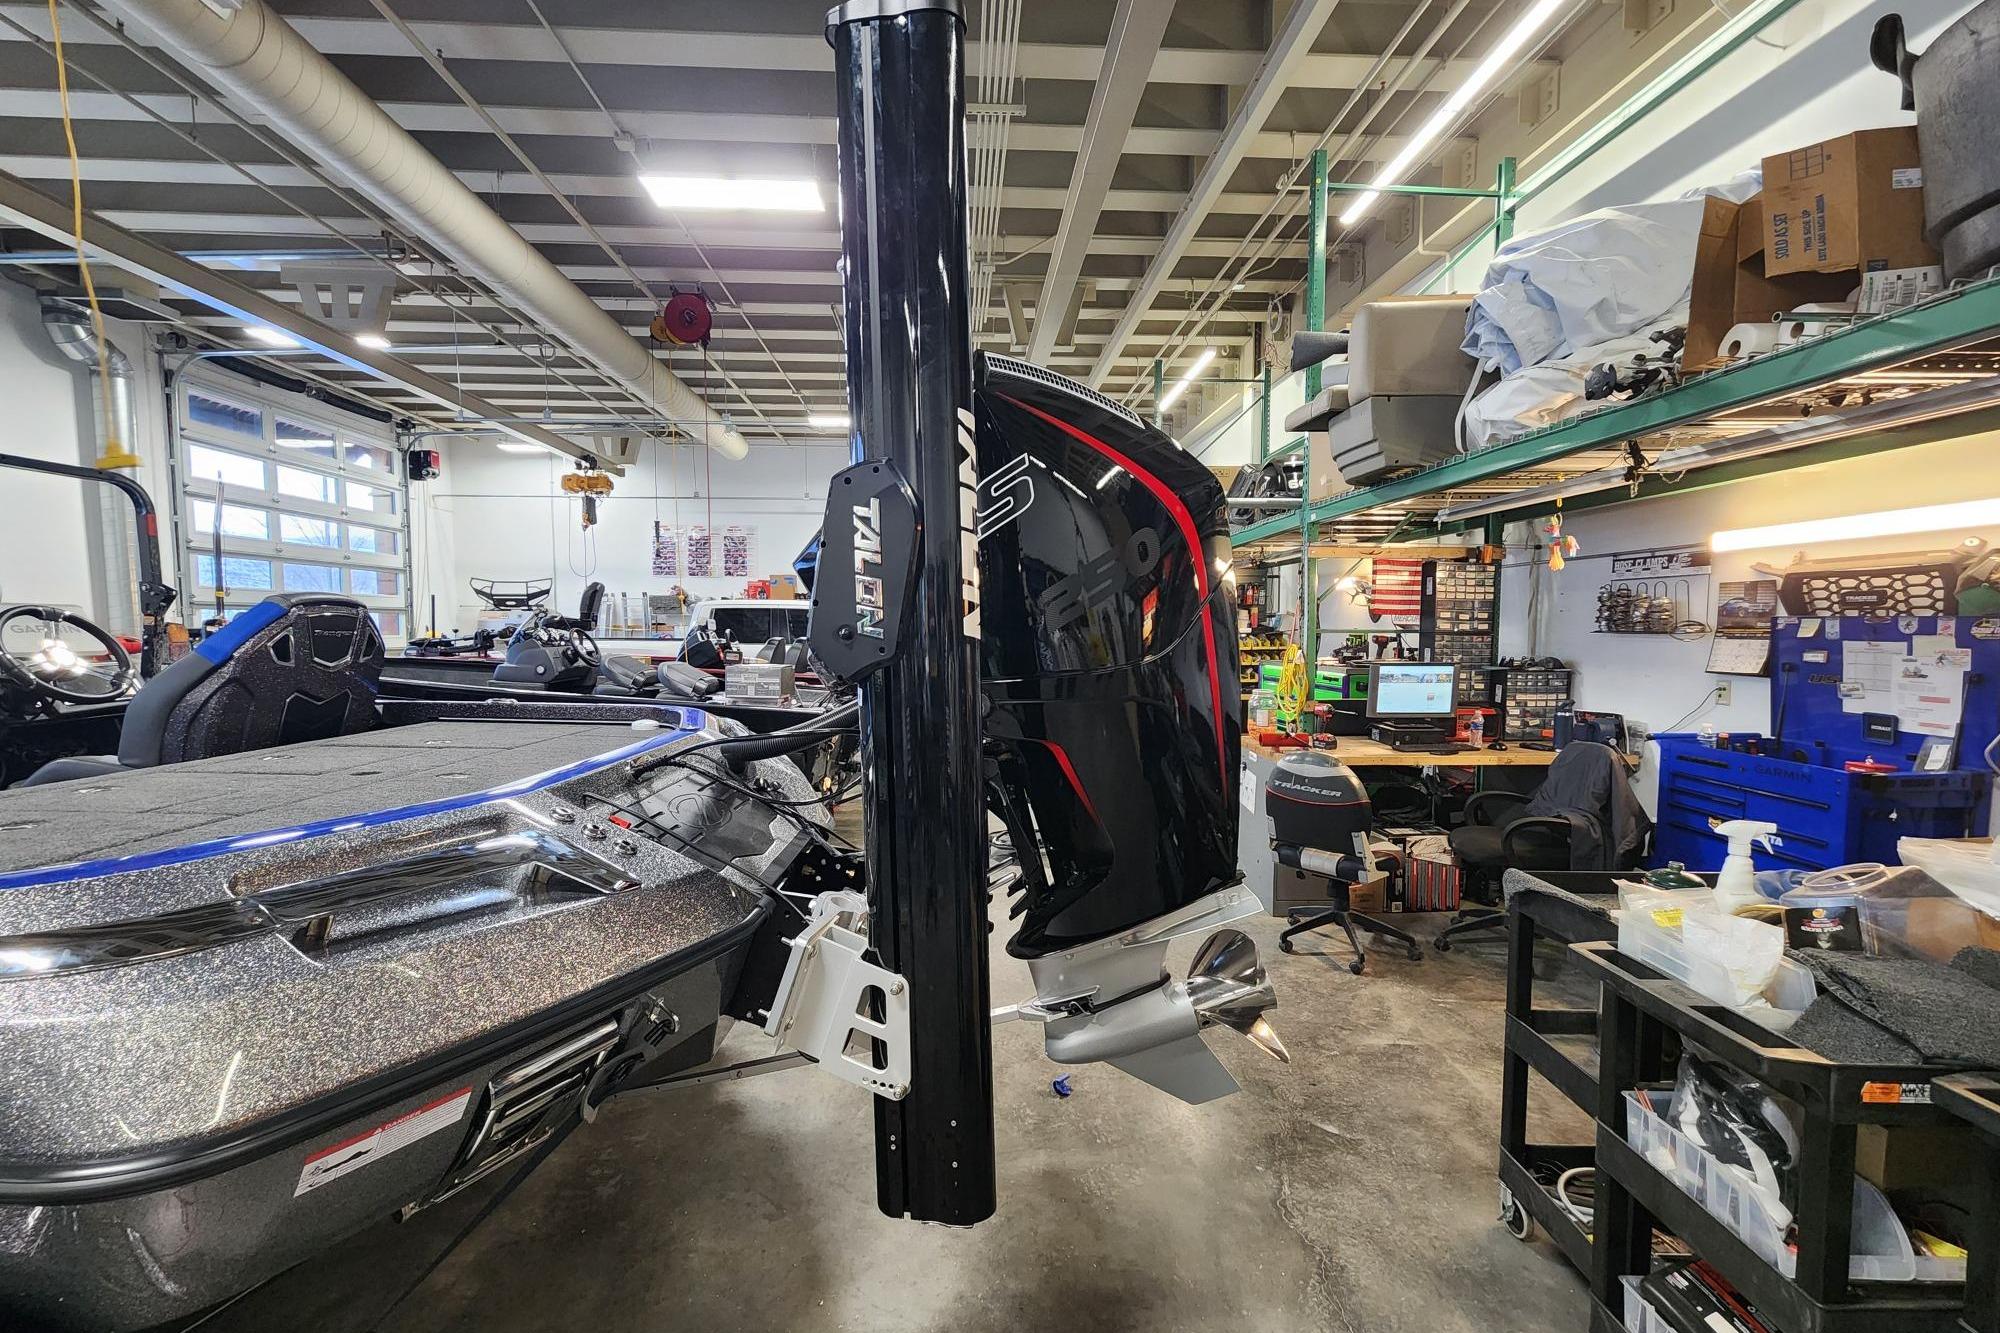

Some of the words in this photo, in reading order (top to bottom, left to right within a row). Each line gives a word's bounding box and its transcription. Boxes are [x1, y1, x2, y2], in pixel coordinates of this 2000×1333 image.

[1773, 212, 1788, 227] SET
[1801, 209, 1811, 219] UP
[1774, 227, 1788, 238] AS
[1802, 220, 1812, 236] SIDE
[1774, 239, 1790, 260] SOLD
[1803, 237, 1813, 253] THIS
[852, 497, 885, 639] TALON
[1614, 559, 1634, 569] HOSE
[1635, 556, 1669, 568] CLAMPS
[1755, 764, 1814, 784] GARMIN
[1273, 779, 1343, 797] TRACKER
[384, 1109, 423, 1130] DANGER
